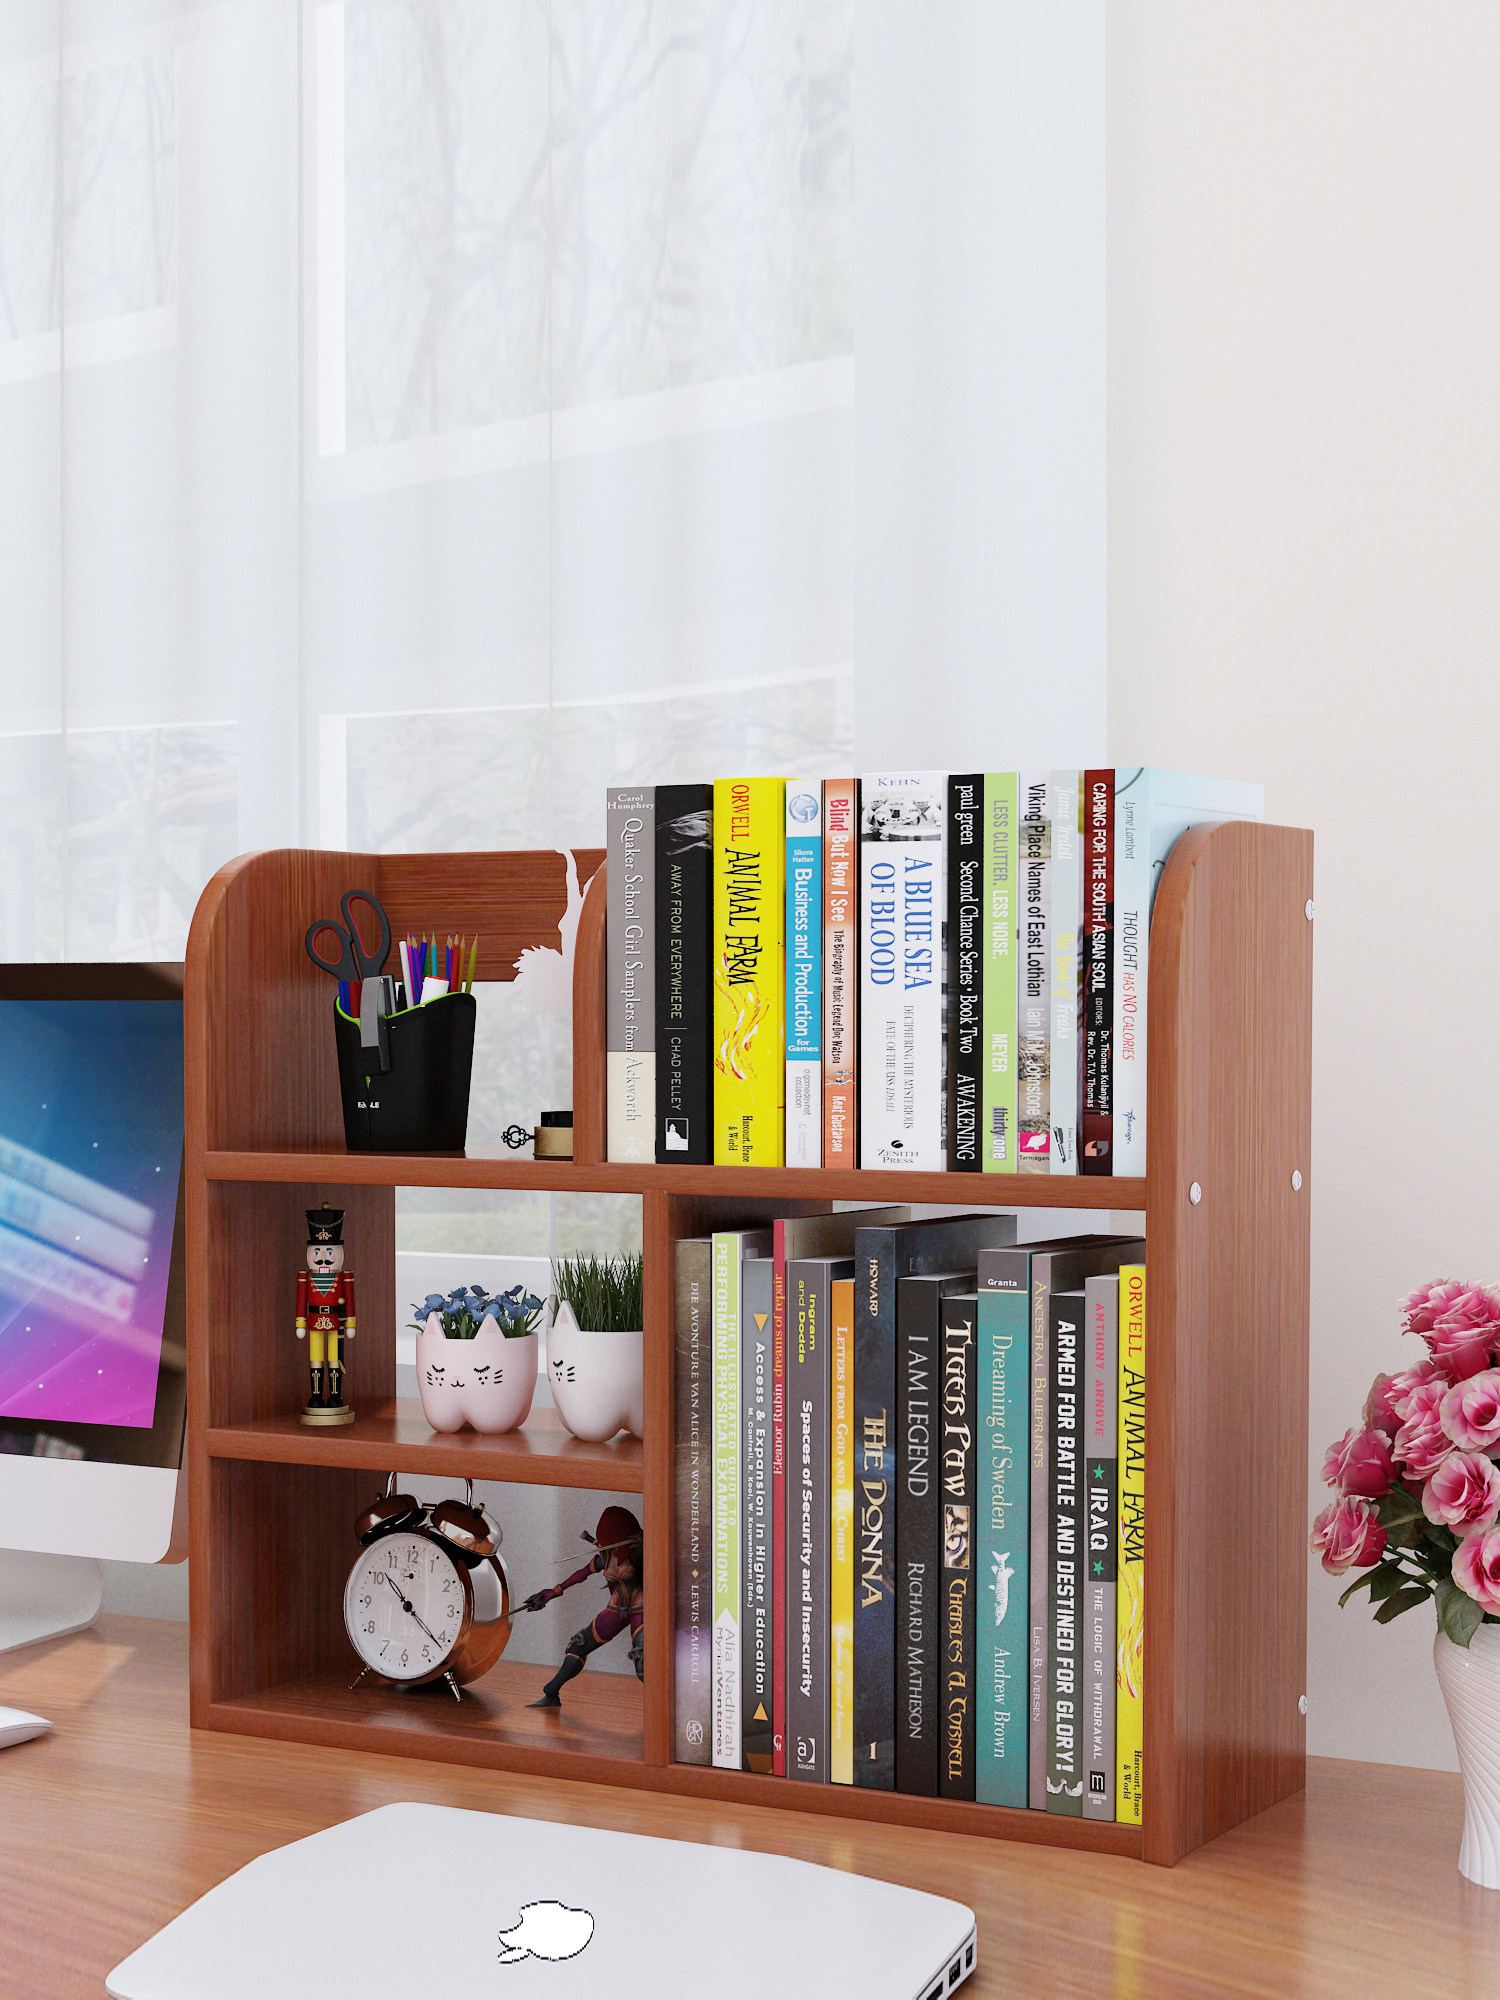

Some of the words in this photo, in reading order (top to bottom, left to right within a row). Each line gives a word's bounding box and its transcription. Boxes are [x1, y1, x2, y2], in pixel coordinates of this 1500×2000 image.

[617, 794, 643, 802] Carol
[731, 785, 750, 842] ORWELL
[829, 800, 849, 831] Blind
[956, 786, 978, 809] paul
[993, 800, 1007, 827] LESS
[1025, 784, 1045, 821] Viking
[1092, 784, 1106, 826] CARING
[1123, 802, 1135, 826] Lynne
[621, 818, 643, 869] Quaker
[830, 835, 849, 857] But
[956, 814, 974, 845] green
[1027, 825, 1044, 857] Place
[1092, 830, 1106, 852] FOR
[1123, 828, 1135, 859] Lambert
[830, 862, 849, 886] Now
[904, 857, 932, 871] A
[993, 833, 1007, 885] CLUTTER.
[1092, 857, 1106, 878] THE
[670, 865, 682, 896] AWAY
[724, 848, 762, 926] ANIMAL
[870, 863, 895, 893] OF
[959, 861, 979, 900] Second
[1027, 862, 1044, 903] Names
[625, 875, 643, 920] School
[794, 869, 812, 930] Business
[831, 899, 848, 921] See
[904, 881, 932, 943] BLUE
[992, 890, 1007, 917] LESS
[1027, 906, 1044, 919] of
[1092, 882, 1106, 921] SOUTH
[670, 900, 682, 934] FROM
[959, 906, 979, 945] Chance
[1027, 923, 1044, 948] East
[625, 925, 643, 955] Girl
[795, 935, 812, 959] and
[833, 931, 844, 941] The
[870, 901, 895, 984] BLOOD
[992, 922, 1007, 959] NOISE.
[1092, 925, 1106, 958] ASIAN
[1123, 911, 1137, 970] THOUGHT
[725, 935, 763, 986] FARM
[831, 944, 844, 975] Biography
[904, 949, 932, 990] SEA
[959, 951, 979, 984] Series
[1027, 952, 1044, 996] Lothian
[1092, 962, 1106, 992] SOUL
[621, 961, 643, 1021] Samplers
[670, 939, 682, 1019] EVERYWHERE
[833, 986, 844, 1002] Music
[1123, 972, 1134, 991] HAS
[794, 964, 812, 1035] Production
[831, 1005, 844, 1026] Legend
[959, 995, 979, 1023] Book
[1122, 994, 1137, 1013] NO
[625, 1025, 639, 1051] from
[670, 1037, 682, 1067] CHAD
[832, 1028, 843, 1039] Doc
[832, 1040, 842, 1063] Watson
[959, 1028, 979, 1053] Two
[1122, 1016, 1134, 1060] CALORIES
[992, 1034, 1007, 1072] MEYER
[625, 1058, 644, 1121] Ackworth
[670, 1072, 682, 1110] PELLEY
[832, 1096, 846, 1113] Kent
[740, 1116, 753, 1143] Harcourt,
[831, 1115, 845, 1152] Gustavson
[956, 1074, 975, 1160] AWAKENING
[728, 1133, 738, 1151] World
[742, 1146, 753, 1162] Brace
[798, 1280, 806, 1306] and
[870, 1260, 879, 1316] HOWARD
[987, 1279, 1018, 1287] Granta
[717, 1243, 727, 1361] PERFORMING
[1128, 1276, 1142, 1357] ORWELL
[798, 1311, 806, 1363] Dodds
[1033, 1281, 1047, 1373] ANCESTRAL
[1094, 1304, 1105, 1370] ANTHONY
[756, 1342, 765, 1403] Access
[908, 1349, 927, 1395] AM
[944, 1321, 972, 1416] TIGER
[1056, 1321, 1076, 1388] ARMED
[986, 1335, 1013, 1429] Dreaming
[717, 1367, 727, 1454] PHYSICAL
[756, 1411, 765, 1422] &
[1033, 1378, 1047, 1468] BLUEPRINTS
[1056, 1393, 1076, 1430] FOR
[1094, 1380, 1105, 1436] ARNOVE
[801, 1401, 812, 1464] Spaces
[863, 1407, 887, 1471] THE
[908, 1401, 927, 1496] LEGEND
[991, 1433, 1013, 1453] of
[691, 1451, 698, 1464] IN
[755, 1429, 765, 1516] Expansion
[944, 1423, 972, 1496] PAW
[1056, 1437, 1076, 1506] BATTLE
[803, 1468, 812, 1486] of
[992, 1457, 1013, 1530] Sweden
[717, 1459, 727, 1594] EXAMINATIONS
[756, 1523, 765, 1539] in
[801, 1491, 812, 1565] Security
[1056, 1515, 1076, 1554] AND
[1090, 1487, 1108, 1550] IRAQ
[388, 1555, 398, 1568] 11
[407, 1550, 419, 1563] 12
[862, 1479, 887, 1608] DONNA
[373, 1571, 384, 1585] 10
[430, 1560, 434, 1573] 1
[755, 1546, 765, 1602] Higher
[803, 1569, 812, 1601] and
[364, 1595, 372, 1608] 9
[442, 1579, 450, 1592] 2
[908, 1563, 925, 1641] RICHARD
[1093, 1588, 1103, 1610] THE
[447, 1605, 454, 1618] 3
[949, 1578, 967, 1663] CHARLES
[1056, 1561, 1076, 1650] DESTINED
[367, 1620, 375, 1634] 8
[382, 1639, 390, 1652] 7
[437, 1630, 446, 1642] 4
[1093, 1616, 1103, 1654] LOGIC
[400, 1649, 408, 1662] 6
[421, 1645, 429, 1658] 5
[756, 1608, 765, 1694] Education
[801, 1606, 812, 1697] Insecurity
[1093, 1660, 1103, 1676] OF
[908, 1646, 925, 1738] MATHESON
[949, 1672, 967, 1691] A.
[993, 1647, 1011, 1704] Andrew
[1056, 1657, 1076, 1693] FOR
[949, 1699, 967, 1780] CORNELL
[993, 1709, 1011, 1758] Brown
[1056, 1700, 1076, 1772] GLORY!
[1093, 1682, 1103, 1760] WITHDRAWAL
